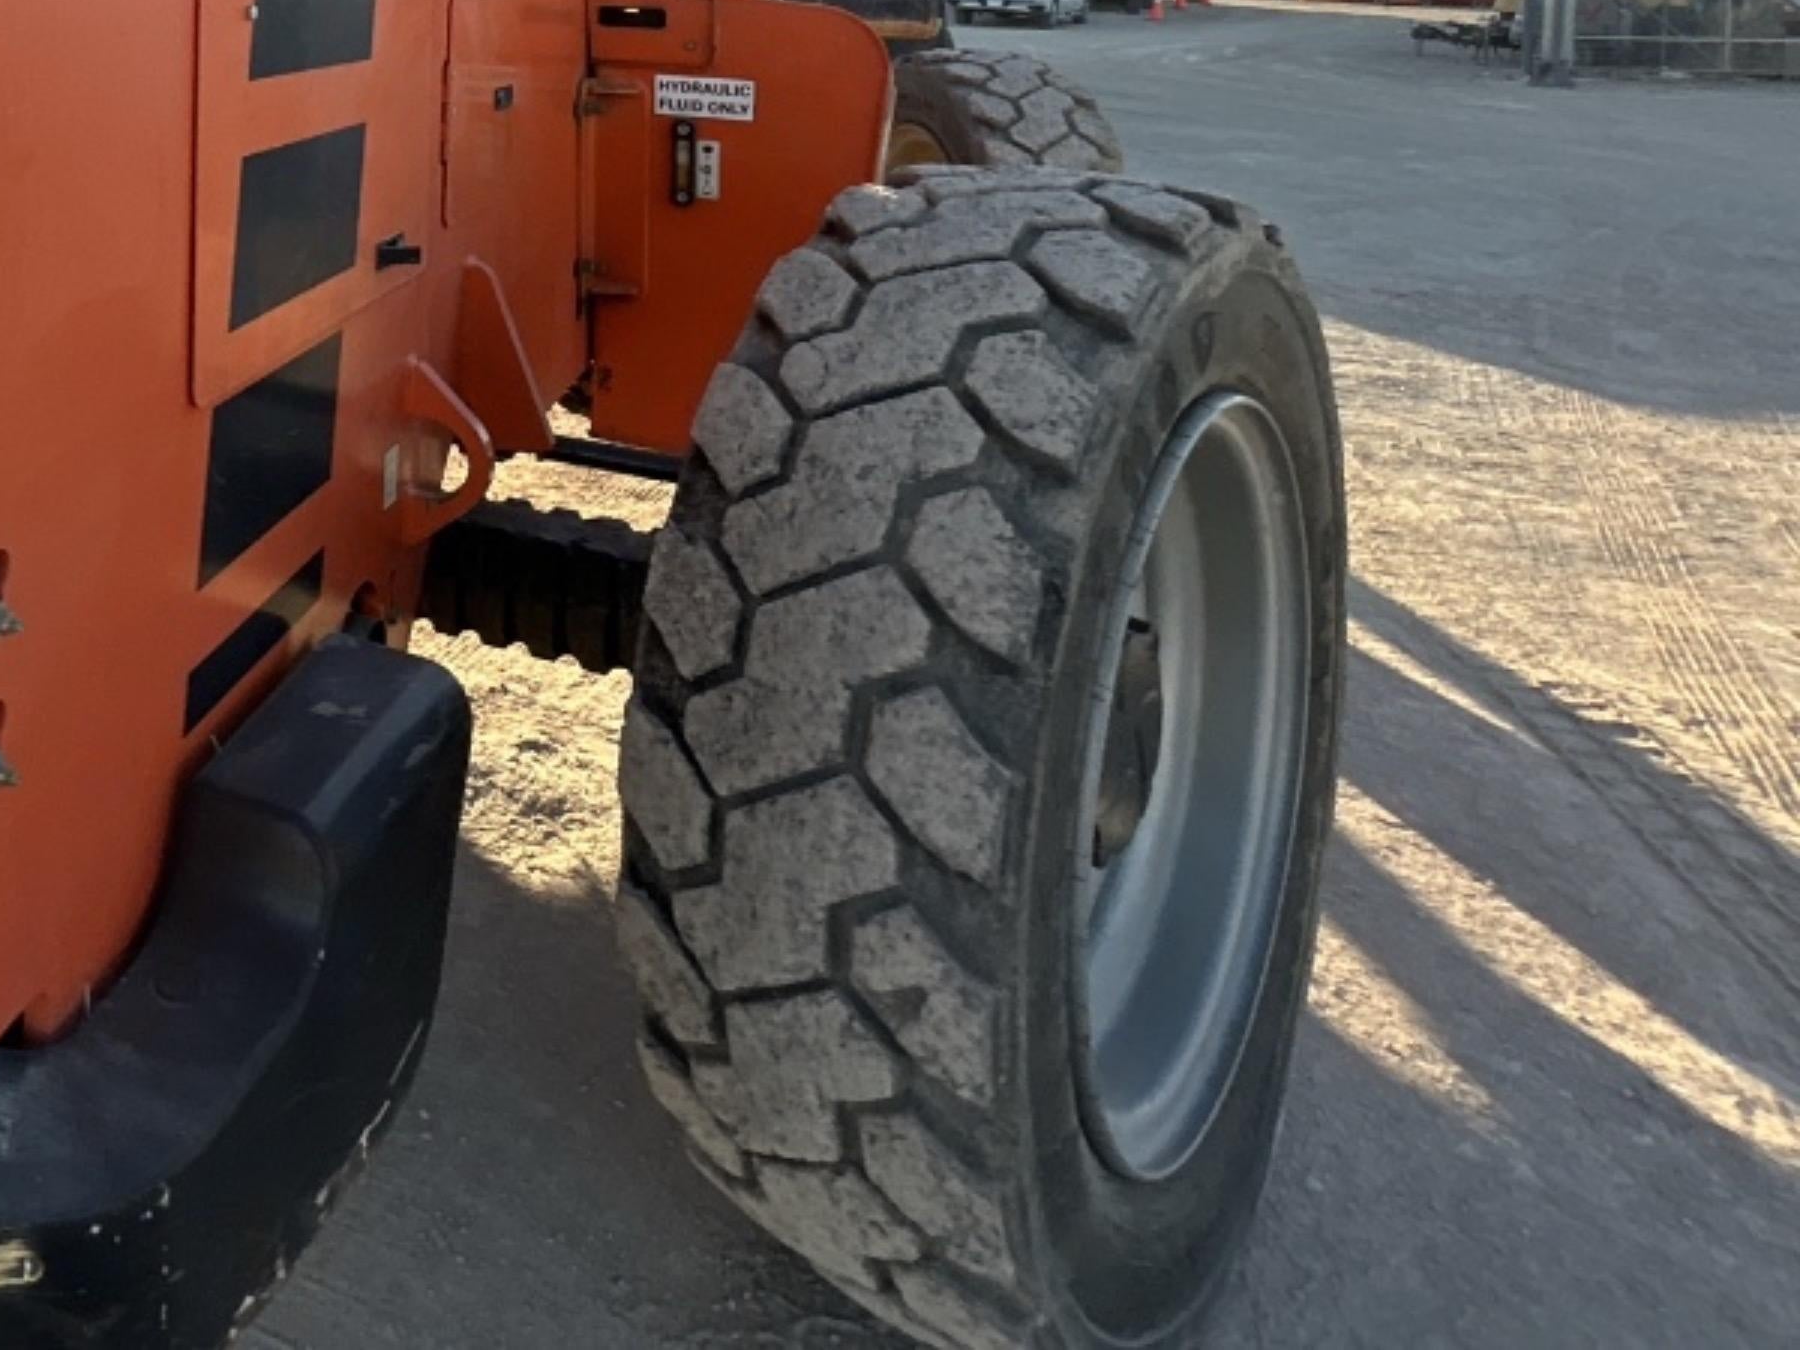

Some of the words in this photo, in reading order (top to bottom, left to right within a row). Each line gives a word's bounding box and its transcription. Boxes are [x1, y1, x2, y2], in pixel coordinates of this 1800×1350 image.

[660, 80, 751, 97] HYDRAULIC
[660, 98, 703, 112] FLUID
[708, 102, 750, 115] ONLY
